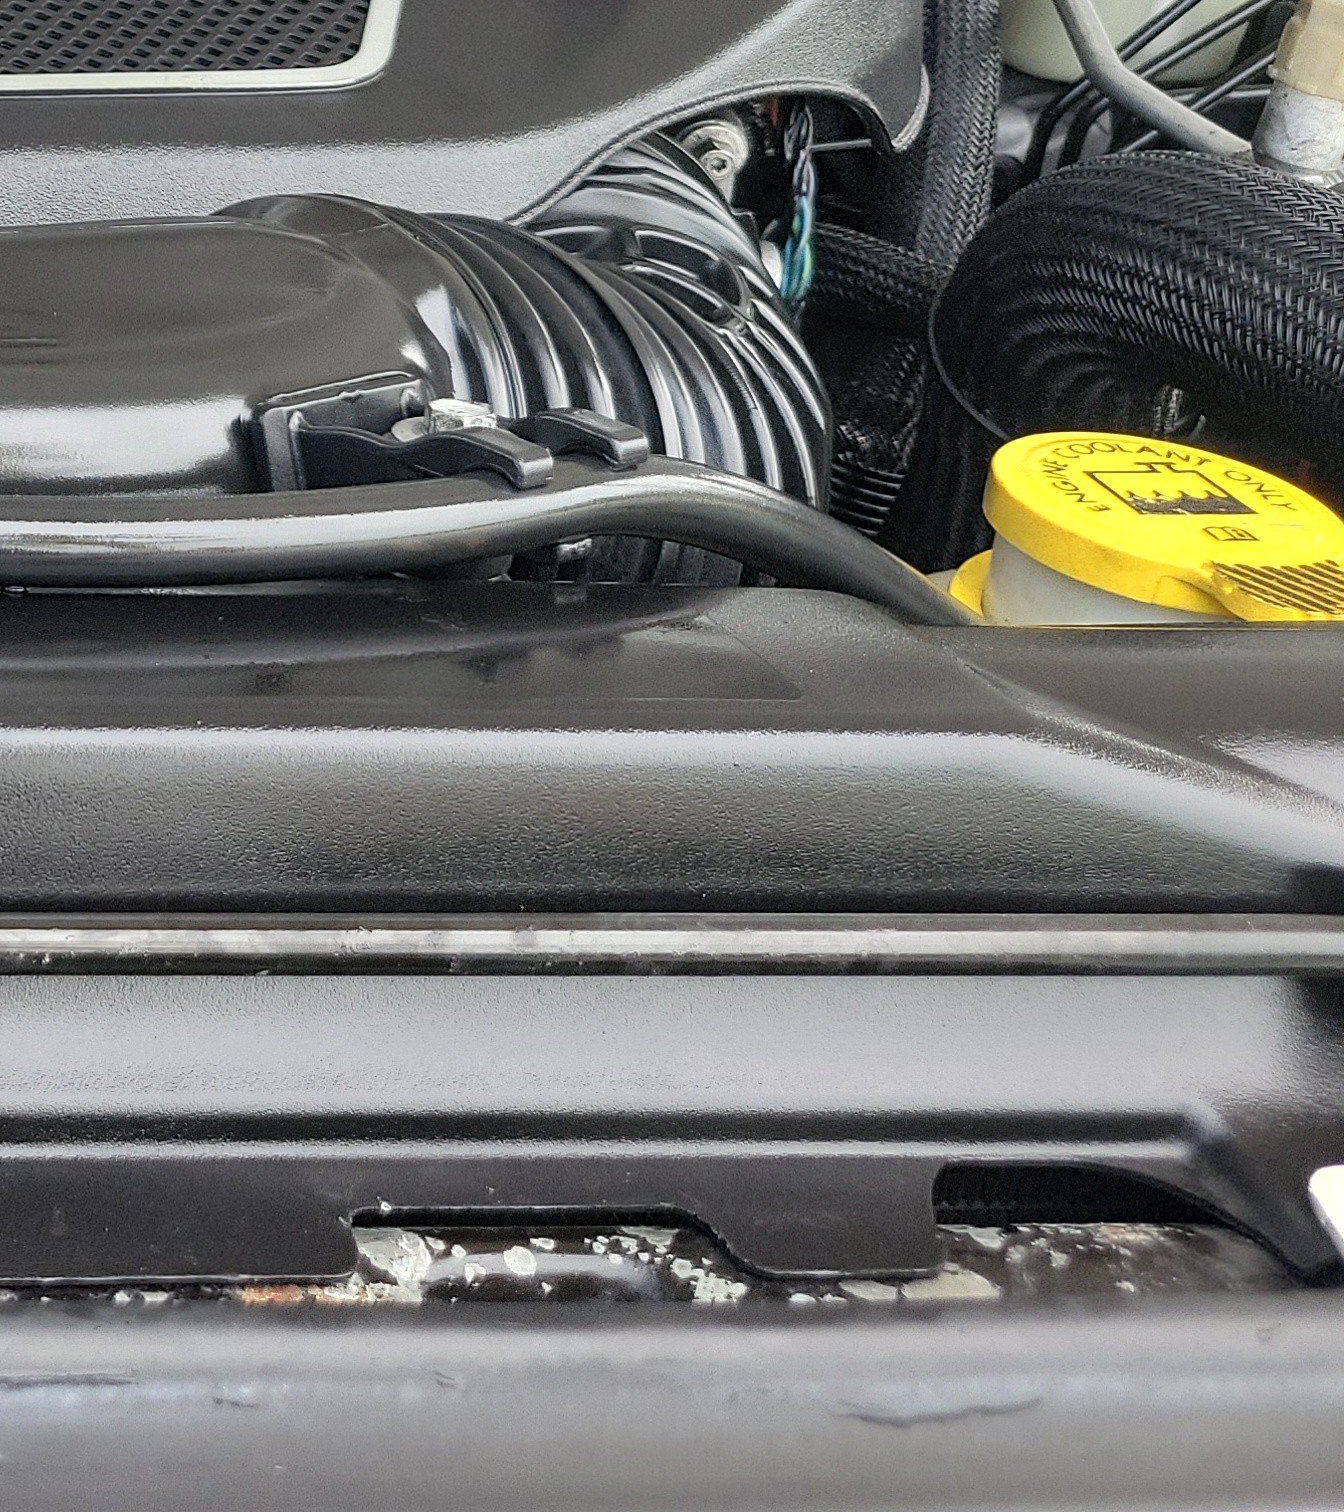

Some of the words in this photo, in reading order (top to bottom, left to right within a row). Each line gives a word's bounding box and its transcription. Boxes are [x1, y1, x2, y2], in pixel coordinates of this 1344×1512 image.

[1053, 440, 1212, 467] COOLANT
[1041, 456, 1112, 514] ENGINE
[1223, 468, 1298, 512] ONLY
